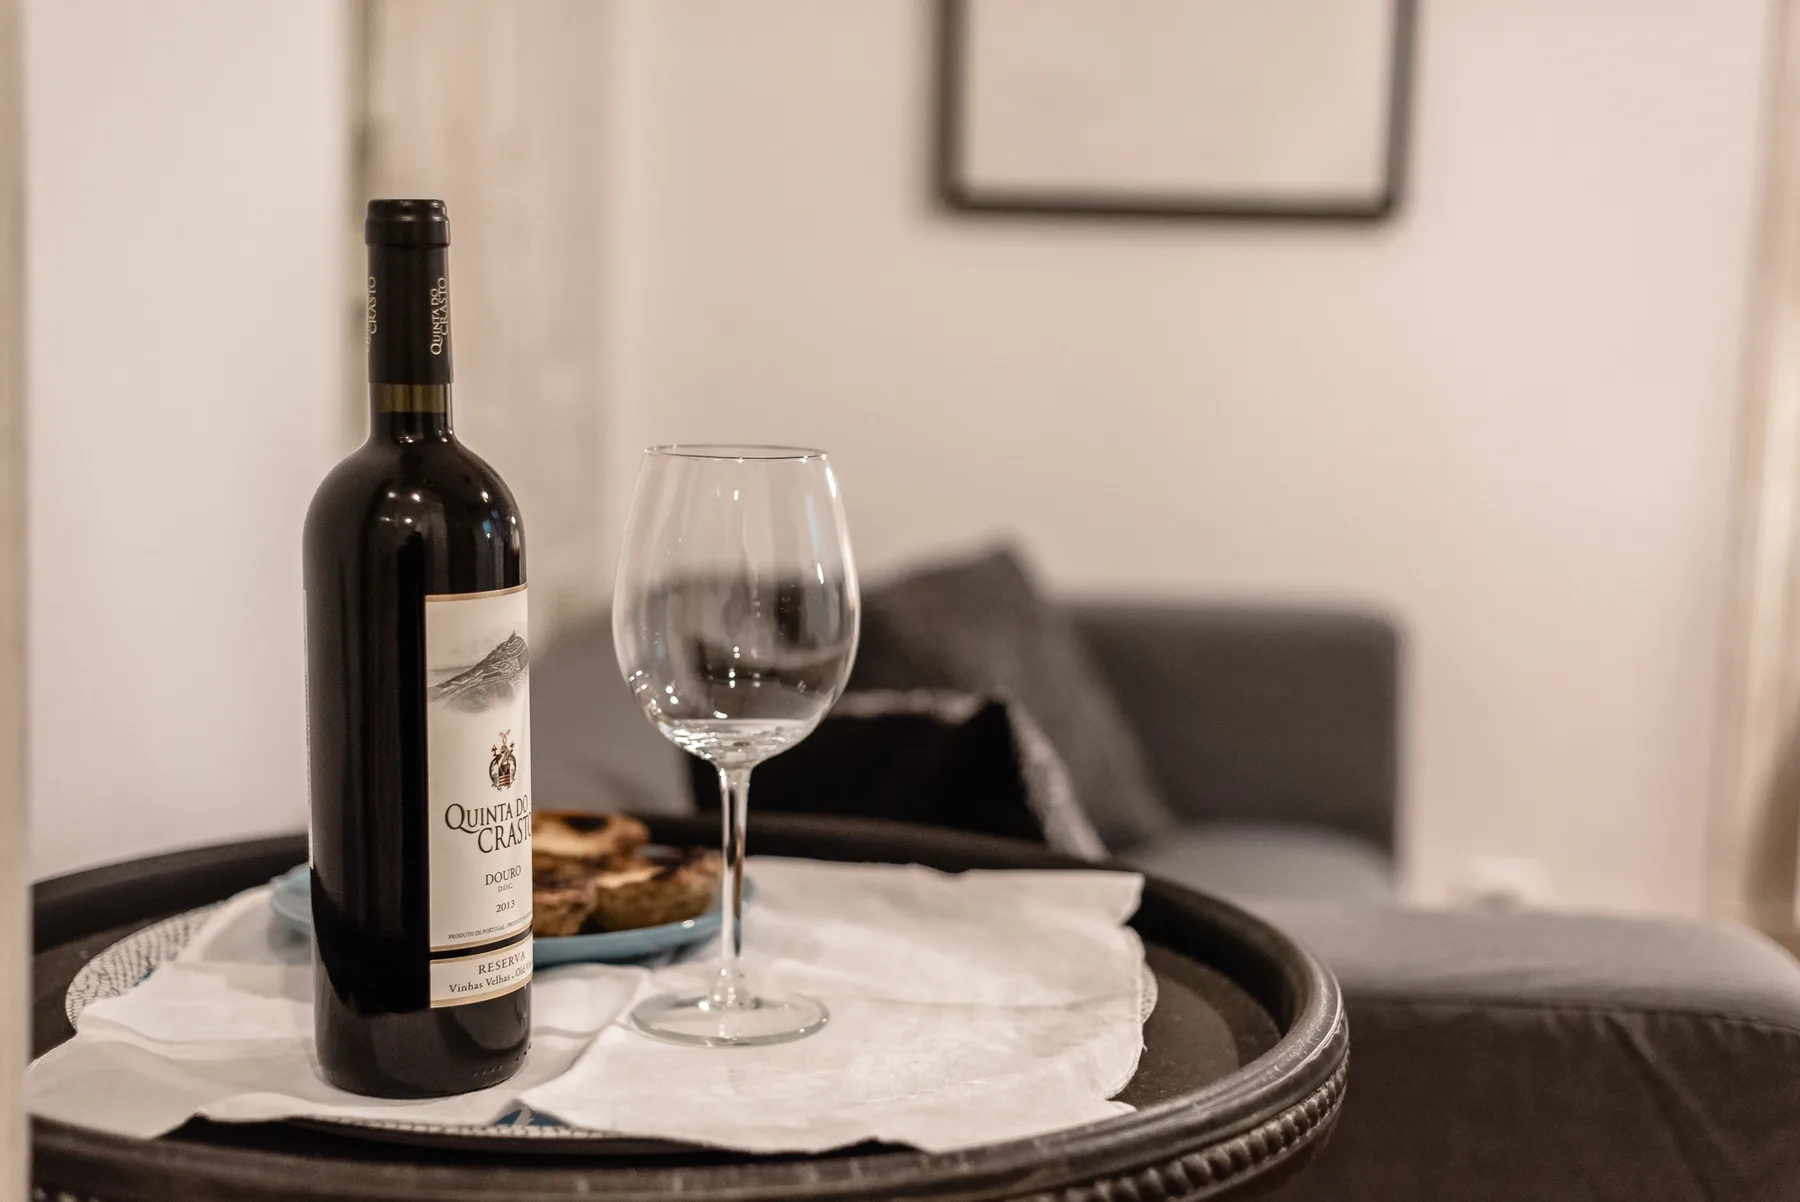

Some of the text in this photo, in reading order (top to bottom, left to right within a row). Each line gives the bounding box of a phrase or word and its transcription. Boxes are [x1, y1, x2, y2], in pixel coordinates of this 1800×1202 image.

[438, 278, 448, 335] CRASTO
[430, 288, 443, 355] QUINTA DO
[445, 794, 528, 834] QUINTA DO
[485, 865, 521, 885] DOURO
[495, 900, 515, 913] 2013
[448, 931, 475, 940] PRODUTO
[482, 924, 505, 934] PORTUGAL
[478, 951, 525, 975] RESERVA
[448, 982, 483, 993] Vinhas
[485, 974, 511, 986] Velhas
[515, 966, 526, 977] Old
